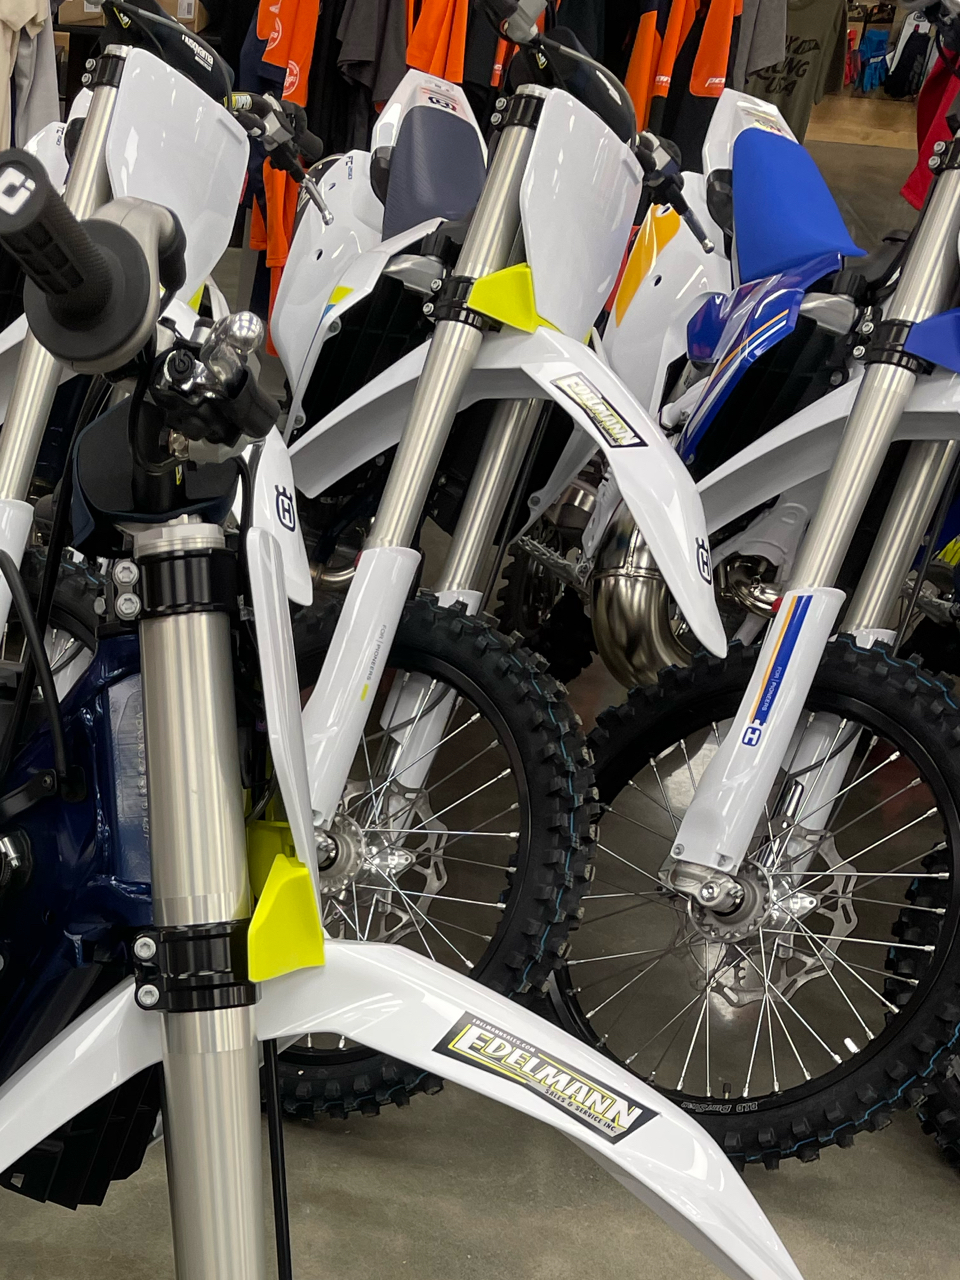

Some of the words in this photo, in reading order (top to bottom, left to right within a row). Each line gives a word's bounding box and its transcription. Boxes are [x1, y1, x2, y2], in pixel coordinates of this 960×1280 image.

[556, 375, 642, 445] EDELMANN
[378, 624, 387, 641] FOR
[366, 643, 381, 681] PIONEERS
[773, 666, 783, 680] FOR
[762, 681, 777, 712] PIONEERS
[472, 1017, 536, 1053] EDELMANNSALES.COM
[449, 1023, 644, 1130] EDELMANN
[544, 1086, 566, 1105] SALES
[574, 1103, 603, 1125] SERVICE
[602, 1119, 618, 1134] INC.
